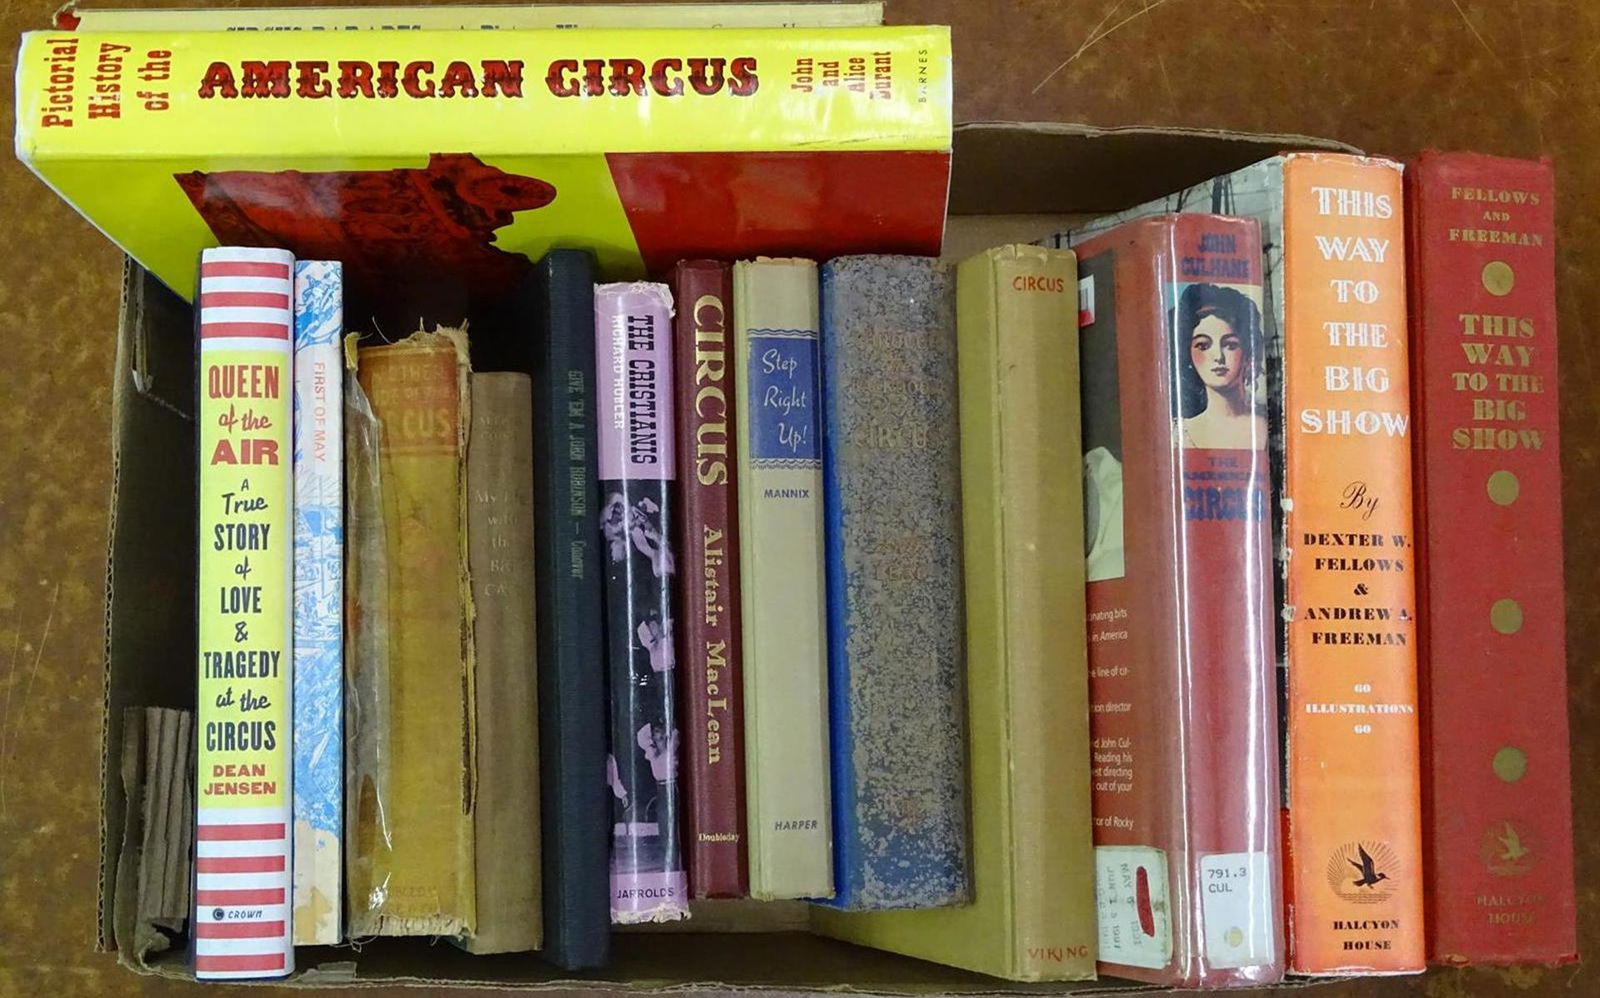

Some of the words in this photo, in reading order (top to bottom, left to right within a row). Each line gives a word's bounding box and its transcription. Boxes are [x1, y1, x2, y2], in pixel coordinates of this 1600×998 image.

[138, 49, 172, 80] the
[791, 58, 813, 92] John
[818, 61, 839, 87] and
[844, 57, 865, 93] Alice
[42, 38, 79, 128] Pictorial
[88, 42, 131, 119] History
[198, 60, 523, 99] AMERICAN
[546, 58, 760, 98] CIRCUS
[144, 90, 169, 111] of
[1311, 187, 1393, 219] THIS
[1451, 187, 1540, 204] FELLOWS
[1483, 211, 1510, 222] AND
[1315, 235, 1390, 263] WAY
[1449, 229, 1543, 246] FREEMAN
[1013, 276, 1064, 293] CIRCUS
[1330, 279, 1380, 304] TO
[628, 315, 655, 351] THE
[1323, 321, 1389, 348] THE
[1459, 314, 1535, 338] THIS
[762, 349, 797, 378] Step
[1461, 343, 1535, 367] WAY
[208, 365, 279, 399] QUEEN
[314, 362, 326, 402] FIRST
[694, 295, 728, 486] CIRCUS
[1324, 365, 1390, 393] BIG
[1452, 372, 1488, 391] TO
[1496, 372, 1544, 393] THE
[628, 359, 657, 464] CRISTIANIS
[764, 386, 806, 415] Right
[1473, 399, 1526, 421] BIG
[218, 403, 238, 433] of
[241, 409, 273, 431] the
[315, 406, 326, 426] OF
[1301, 408, 1409, 437] SHOW
[315, 430, 326, 462] MAY
[778, 423, 807, 452] Up!
[1453, 428, 1547, 450] SHOW
[211, 439, 279, 465] AIR
[241, 479, 249, 491] A
[764, 488, 809, 499] MANNIX
[221, 492, 268, 515] True
[1340, 480, 1380, 521] By
[214, 524, 270, 550] STORY
[1304, 533, 1384, 546] DEXTER
[1392, 535, 1412, 548] W.
[235, 556, 251, 580] of
[703, 524, 723, 627] Alistair
[1315, 558, 1404, 572] FELLOWS
[221, 586, 262, 613] LOVE
[1354, 583, 1369, 596] &
[1304, 608, 1392, 621] ANDREW
[235, 621, 248, 642] &
[1099, 631, 1128, 641] America
[1312, 632, 1407, 646] FREEMAN
[204, 651, 280, 678] TRAGEDY
[216, 687, 234, 708] at
[240, 689, 271, 712] the
[706, 641, 728, 765] MacLean
[1105, 701, 1132, 713] director
[1305, 703, 1414, 714] ILLUSTRATIONS
[206, 721, 276, 751] CIRCUS
[1101, 738, 1116, 749] John
[213, 764, 266, 777] DEAN
[1103, 766, 1133, 780] directing
[204, 782, 276, 795] JENSEN
[775, 820, 818, 831] HARPER
[1113, 817, 1134, 831] Rocky
[699, 832, 739, 843] Doubleday
[1208, 868, 1247, 878] 791.3
[617, 887, 675, 899] JARROLDS
[1208, 884, 1233, 893] CUL
[228, 910, 262, 919] CROWN
[1333, 920, 1400, 930] HALCYON
[1028, 945, 1088, 962] VIKING
[1343, 940, 1391, 950] HOUSE
